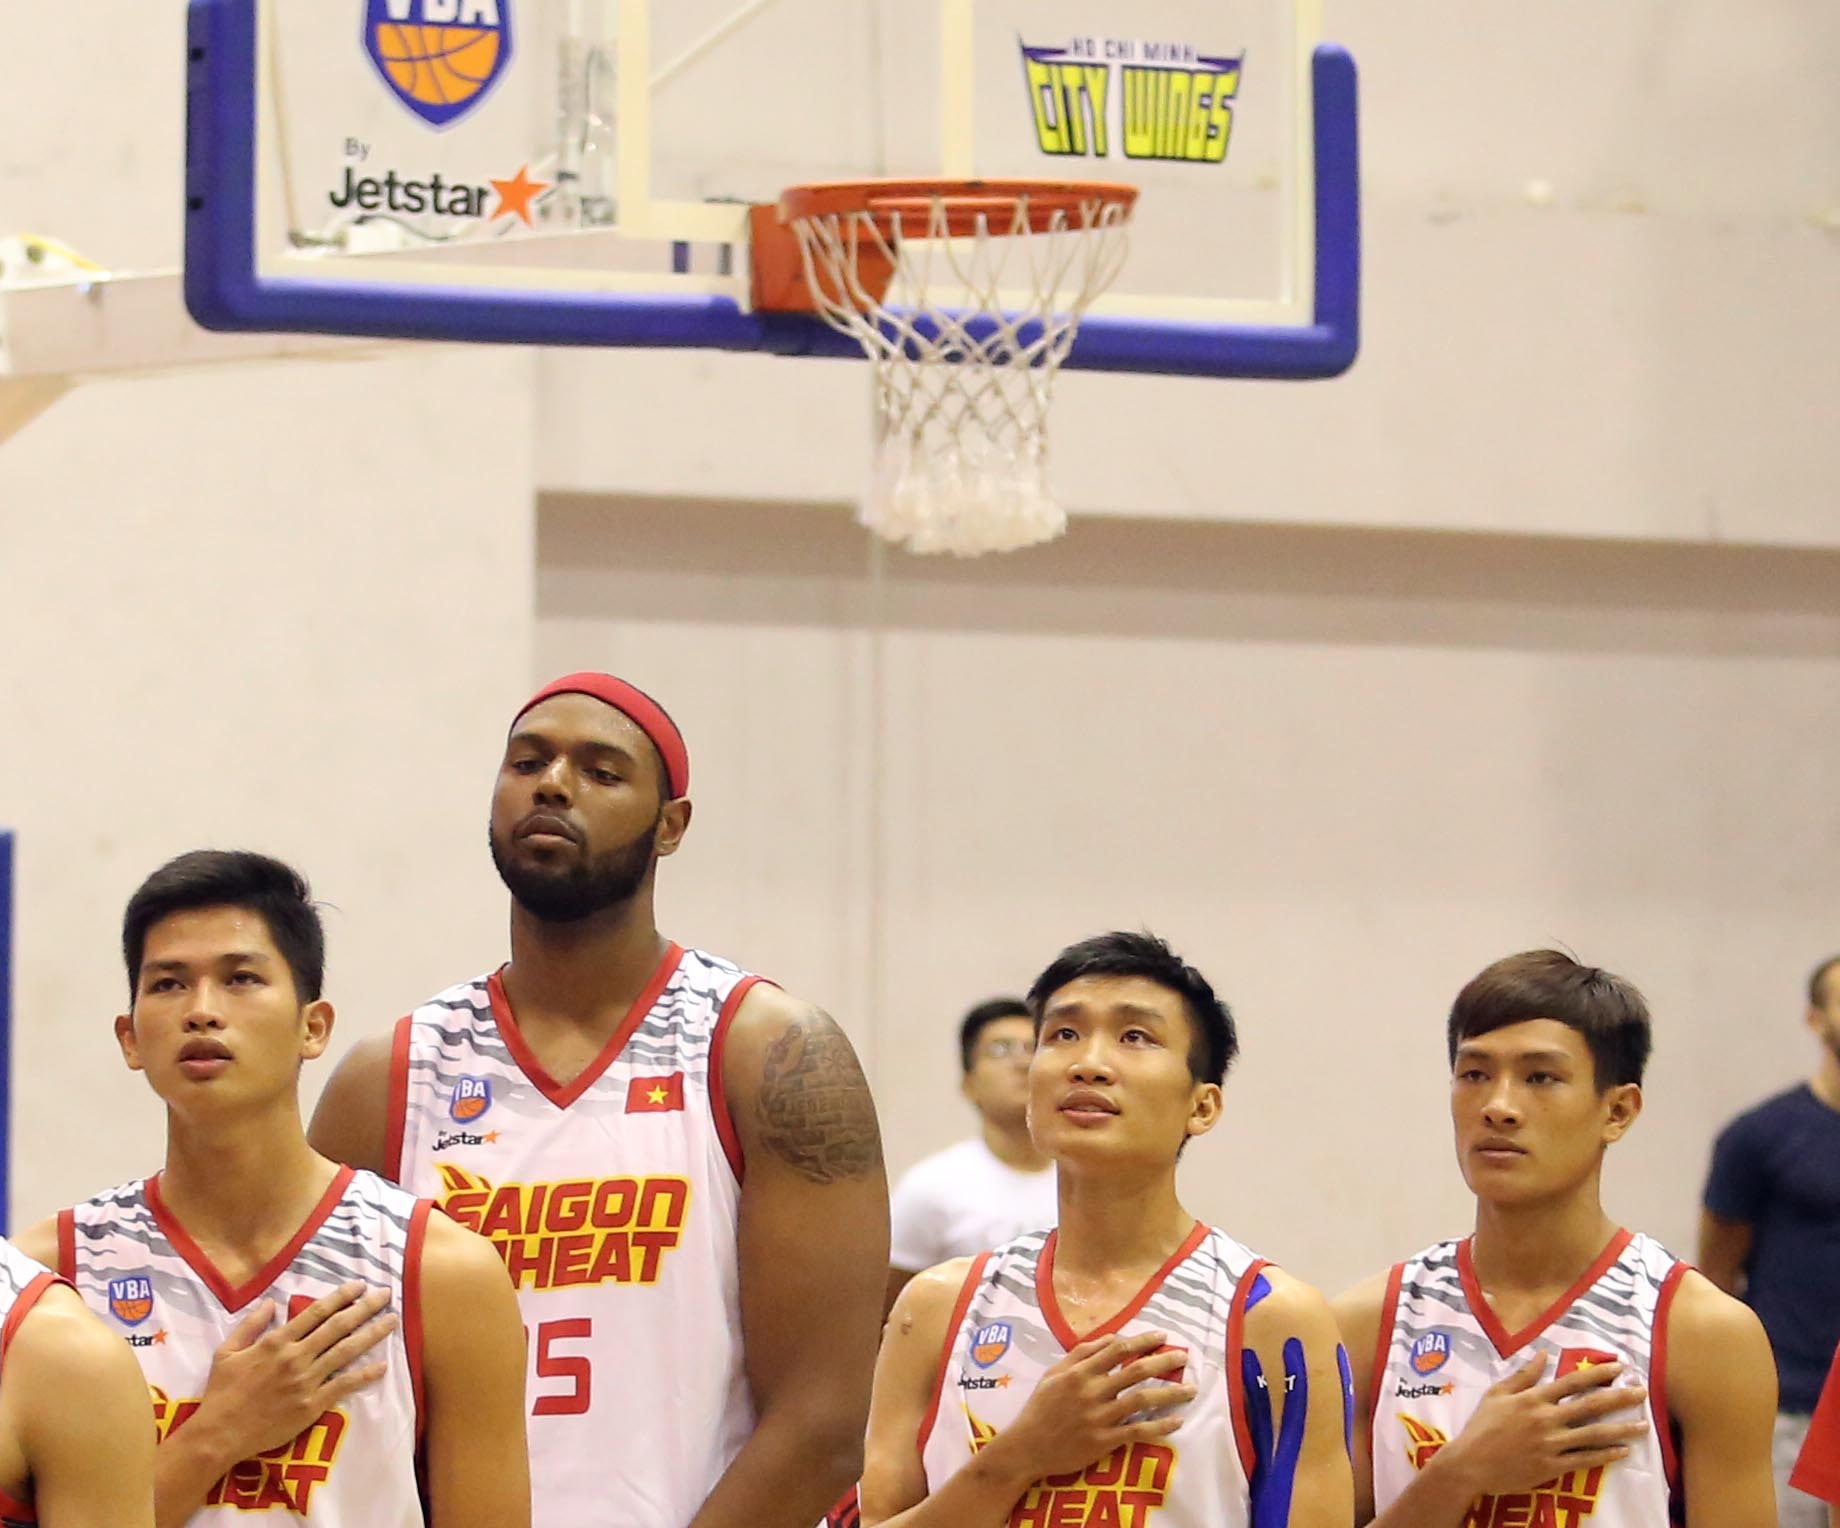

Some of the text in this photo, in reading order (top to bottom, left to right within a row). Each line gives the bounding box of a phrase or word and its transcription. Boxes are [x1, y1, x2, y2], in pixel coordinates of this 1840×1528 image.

[1104, 40, 1135, 59] CHI
[1143, 42, 1198, 61] MINH
[1025, 58, 1239, 163] CITY WINGS
[344, 137, 371, 161] By
[328, 166, 490, 217] Jetstar
[445, 1177, 689, 1237] SAIGON
[506, 1231, 679, 1290] HEAT
[112, 1279, 150, 1300] VBA
[979, 1326, 1009, 1345] VBA
[1418, 1333, 1446, 1354] VBA
[525, 1318, 592, 1415] 5
[1395, 1384, 1442, 1399] Jetstar
